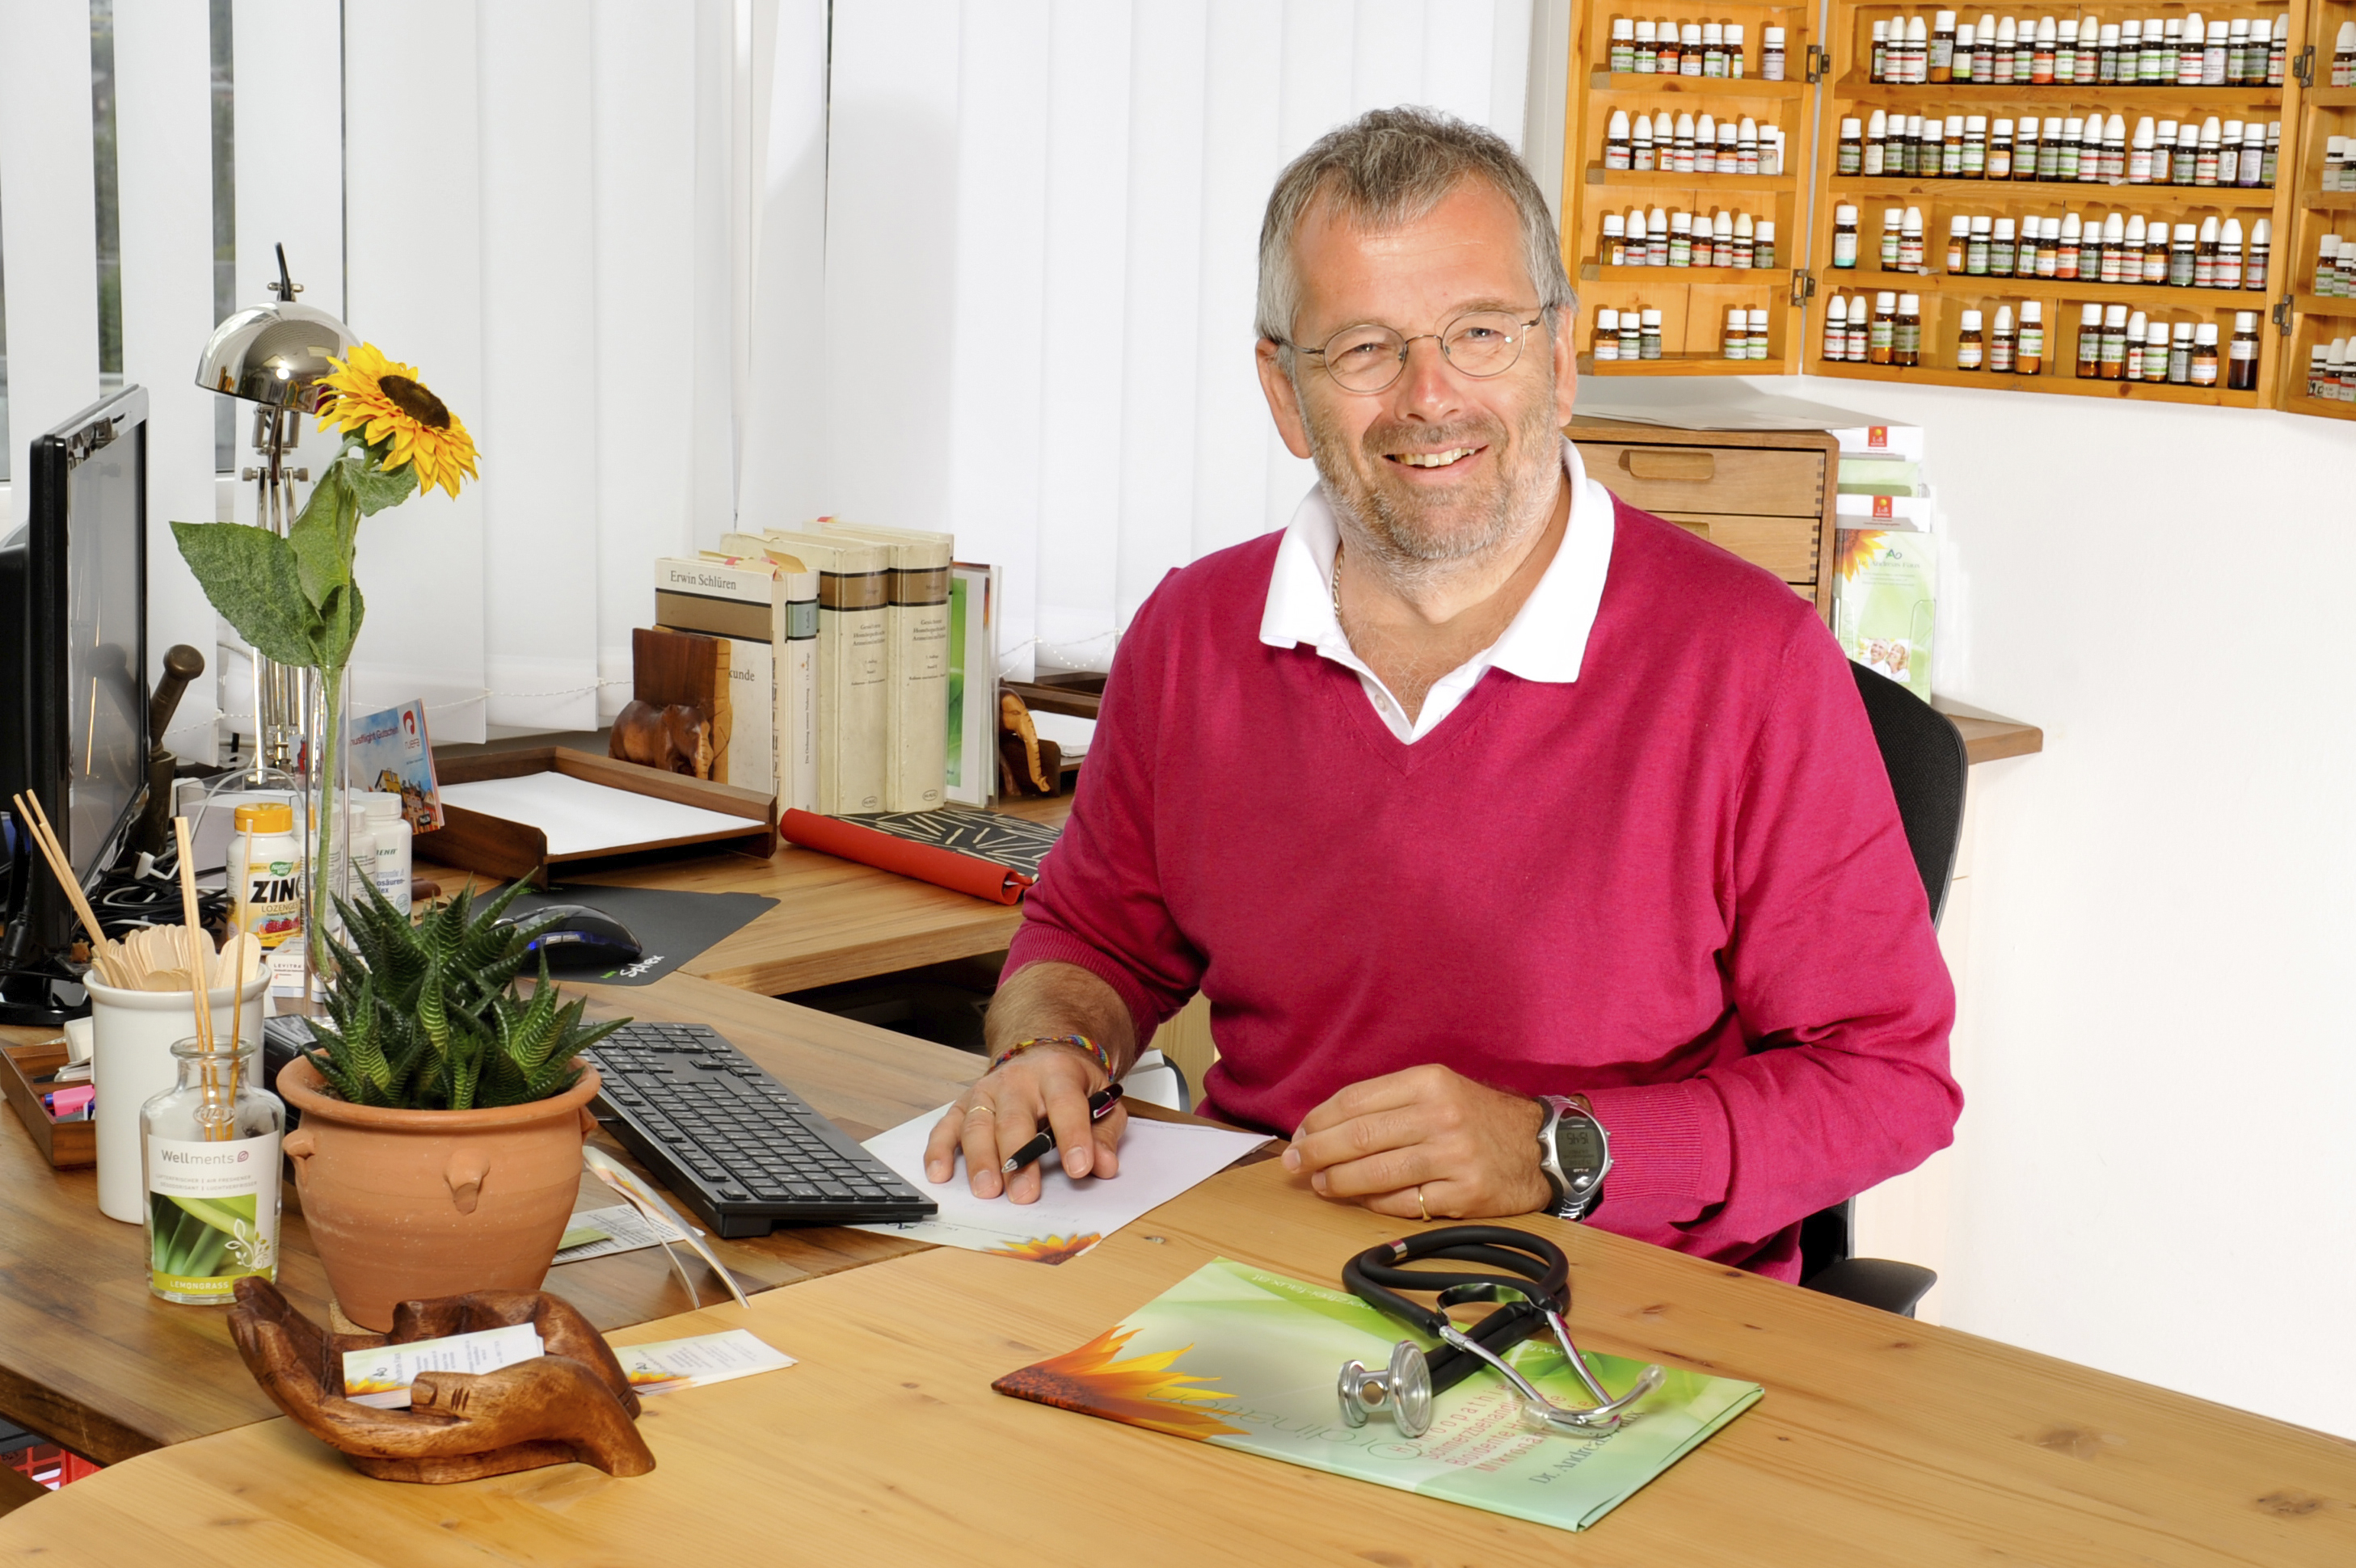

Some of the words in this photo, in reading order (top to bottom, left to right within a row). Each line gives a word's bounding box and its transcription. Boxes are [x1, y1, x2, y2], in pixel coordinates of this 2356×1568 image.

[670, 570, 697, 585] Erwin
[698, 573, 736, 591] Schlüren
[261, 902, 298, 913] LOZENGES
[162, 1149, 234, 1165] Wellments
[218, 1174, 251, 1182] FRESHENER
[170, 1279, 229, 1290] LEMONGRASS
[1528, 1470, 1561, 1485] Dr.
